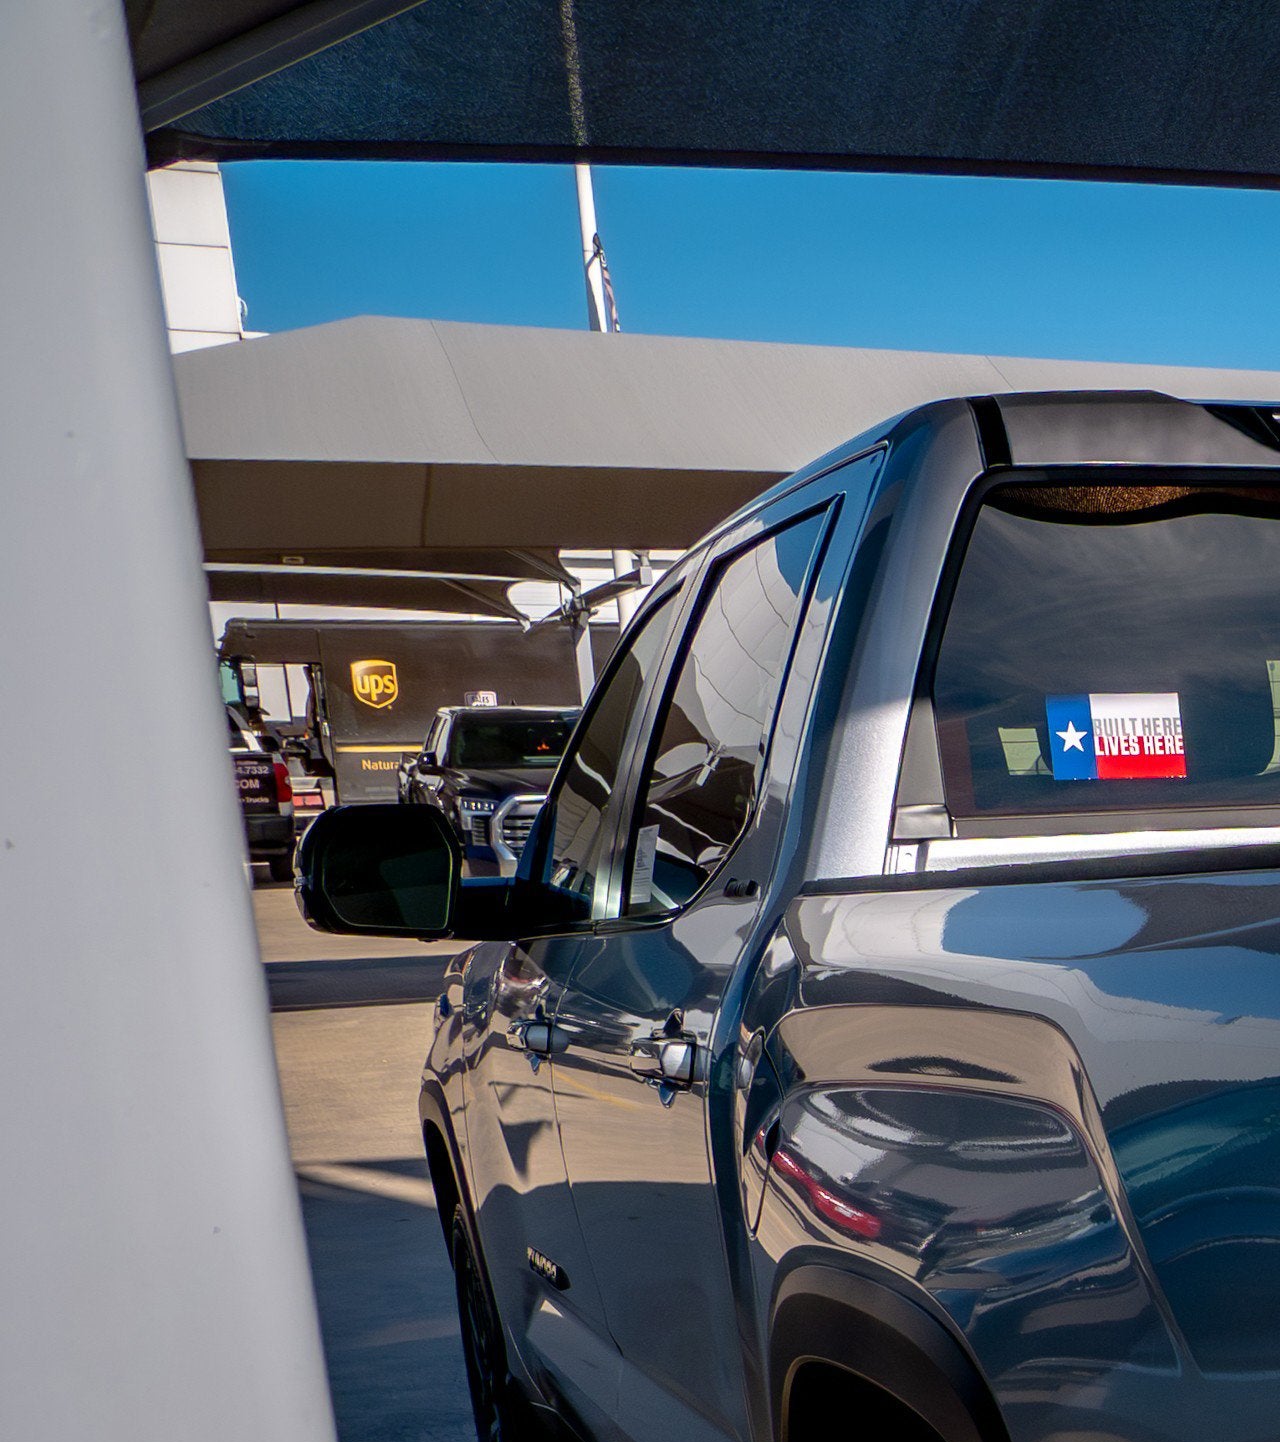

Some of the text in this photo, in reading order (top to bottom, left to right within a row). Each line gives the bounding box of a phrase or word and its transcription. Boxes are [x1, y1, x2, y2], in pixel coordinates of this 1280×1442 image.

[1093, 717, 1182, 736] BUILT HERE
[1095, 736, 1184, 756] LIVES HERE
